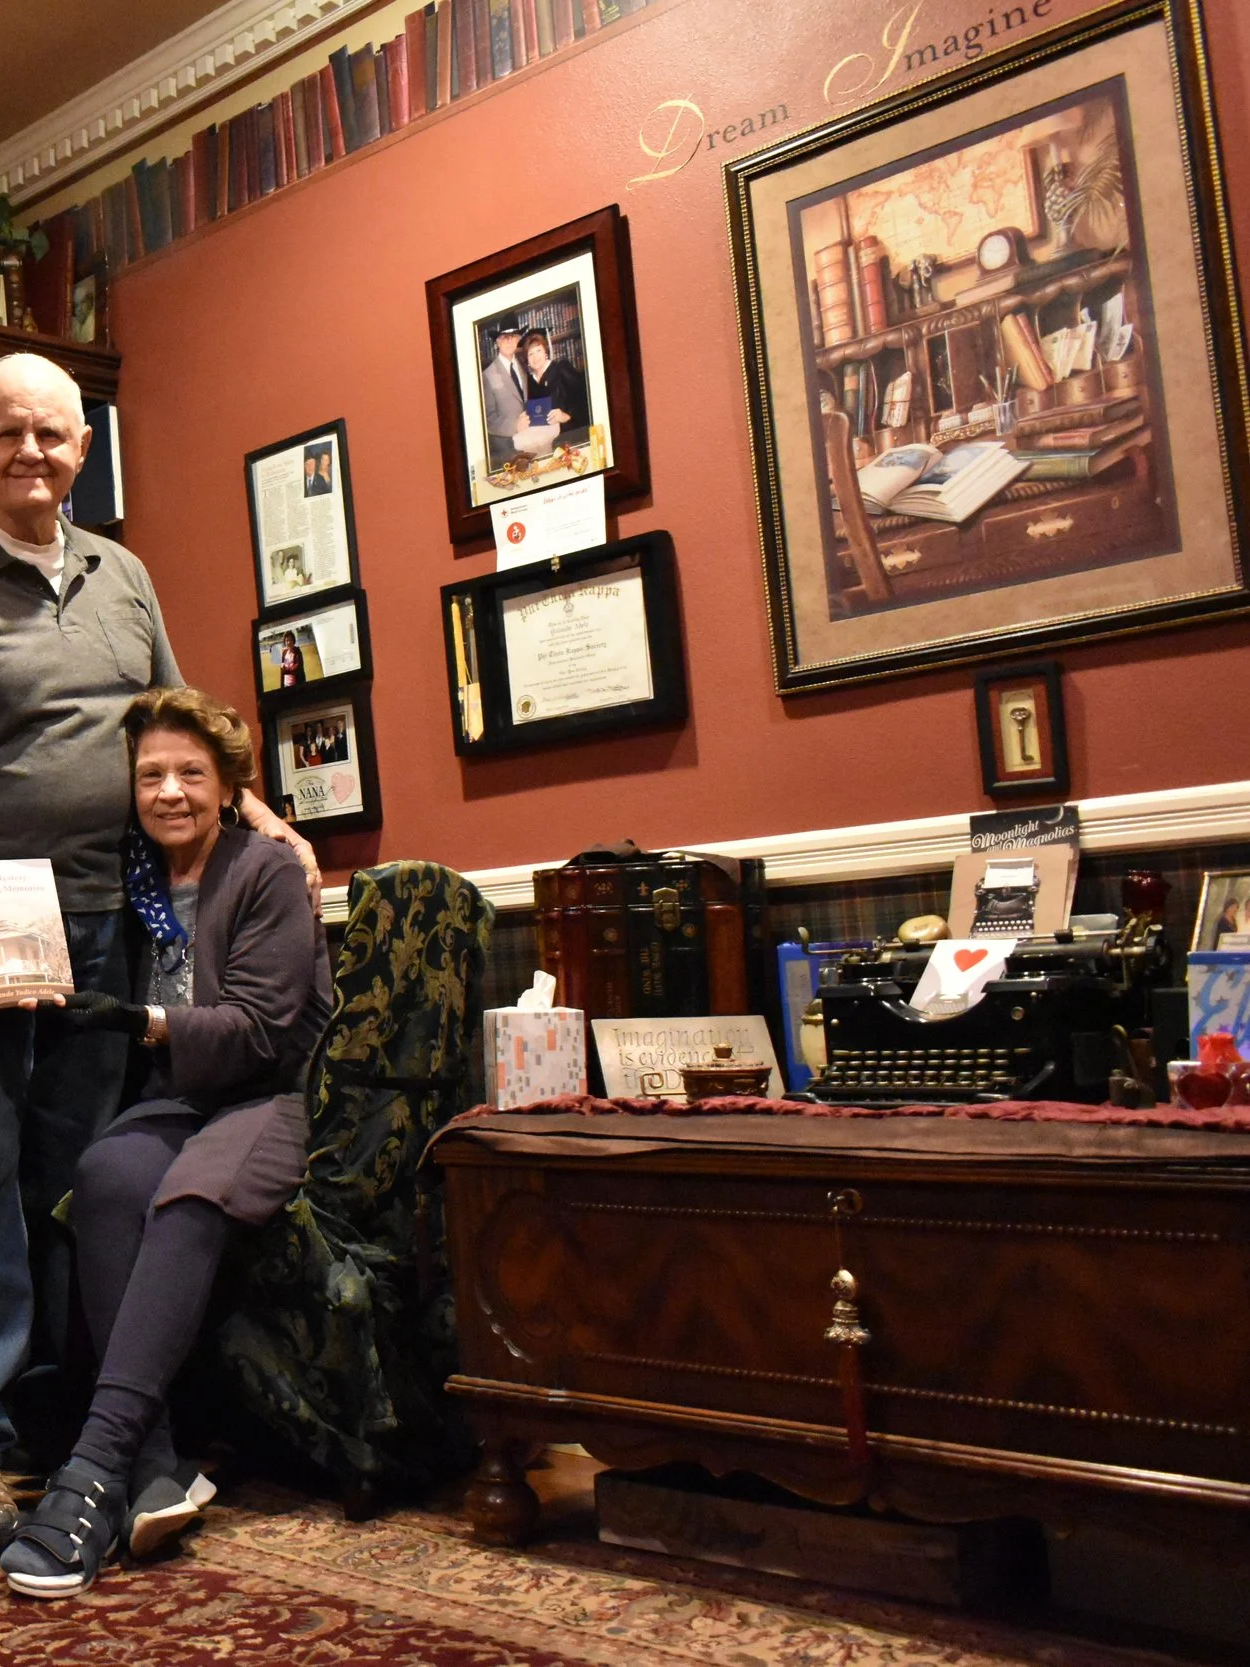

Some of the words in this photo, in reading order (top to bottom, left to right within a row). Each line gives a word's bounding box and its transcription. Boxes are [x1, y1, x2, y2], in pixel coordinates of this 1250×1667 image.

[824, 0, 1054, 104] Imagine
[625, 93, 791, 191] Dream
[299, 786, 325, 800] NANA
[972, 820, 1039, 849] Moonlight
[1002, 825, 1075, 850] Magnolias
